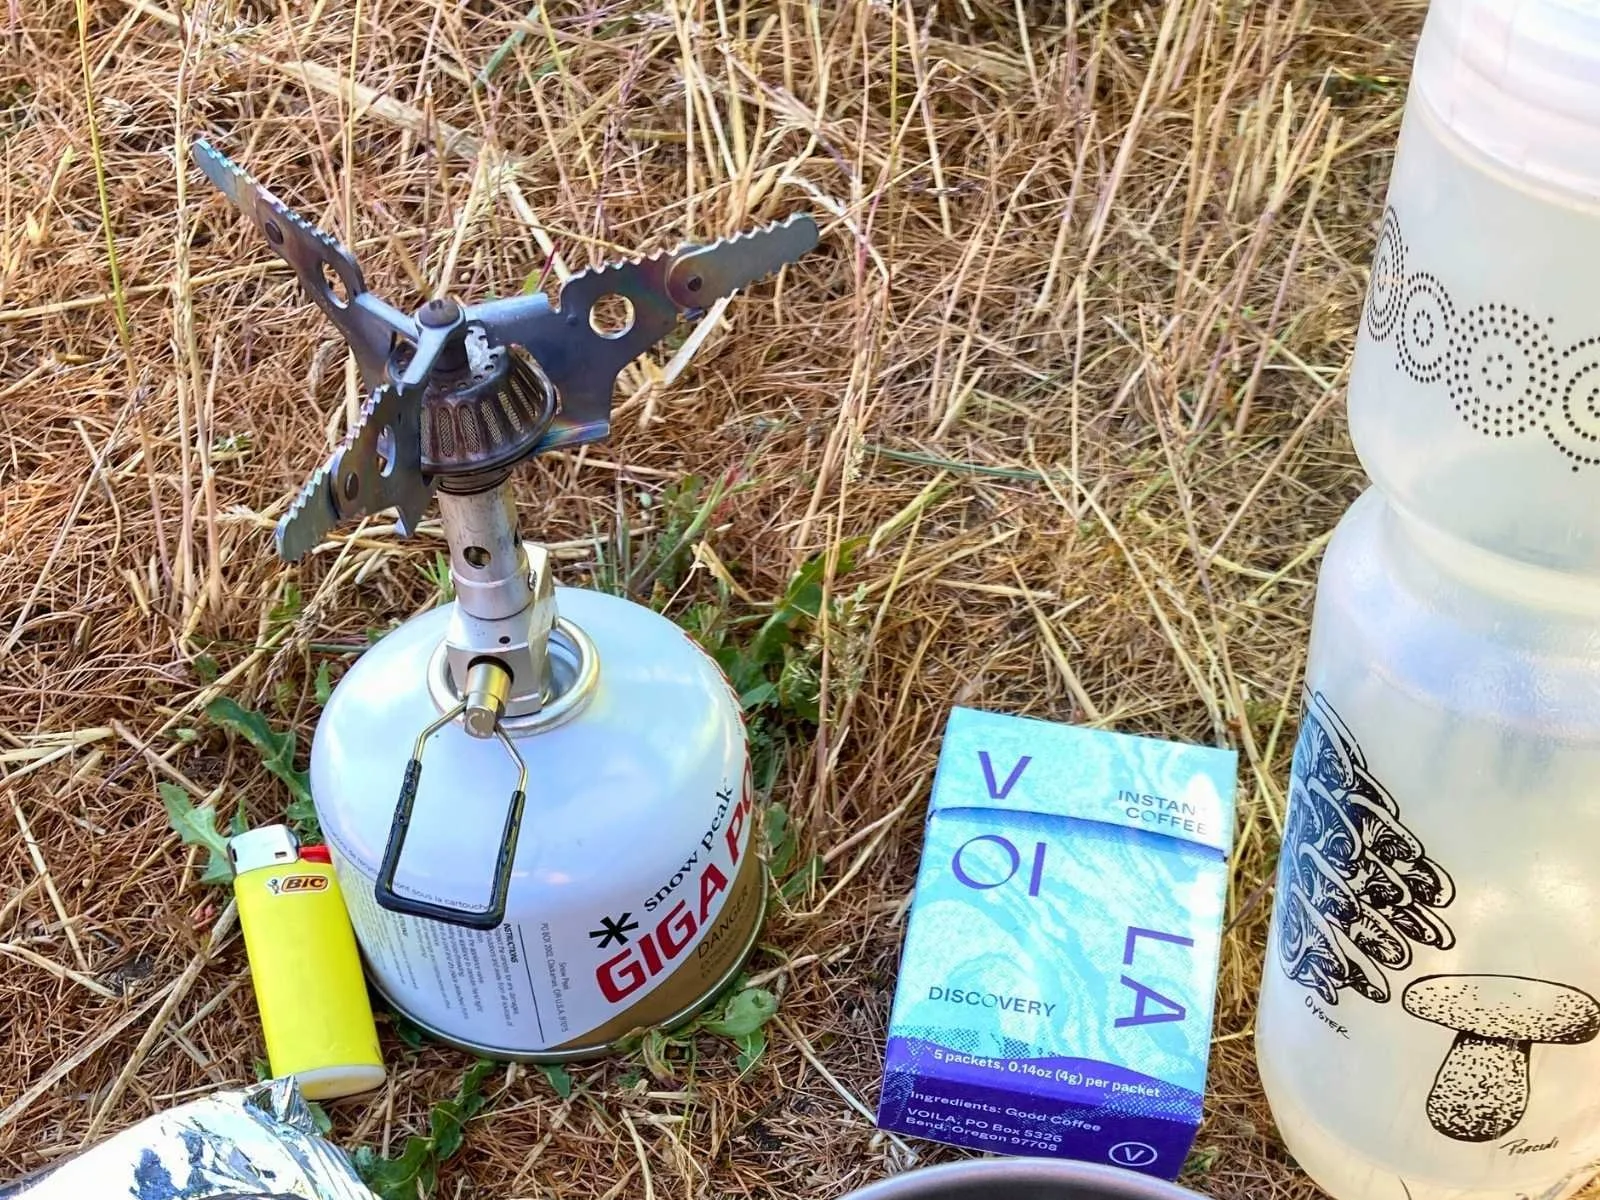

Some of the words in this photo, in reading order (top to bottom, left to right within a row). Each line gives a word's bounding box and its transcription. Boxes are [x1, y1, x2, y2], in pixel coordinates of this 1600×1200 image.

[978, 751, 1032, 800] V
[1118, 790, 1204, 816] INSTAN
[1126, 807, 1207, 835] COFFEE
[644, 851, 698, 912] snow
[701, 787, 734, 852] peak
[286, 878, 325, 890] BIC
[596, 863, 729, 1004] GIGA
[726, 757, 753, 867] PO
[698, 884, 749, 959] DANGER
[928, 986, 1057, 1017] DISCOVERY
[934, 1049, 944, 1060] 5
[945, 1052, 1005, 1072] packets,
[1008, 1061, 1052, 1080] 0.14oz
[1055, 1069, 1083, 1087] (4g)
[1085, 1076, 1109, 1090] per
[1112, 1079, 1161, 1098] packet
[911, 1091, 1001, 1114] Ingredients:
[1005, 1107, 1047, 1122] Good
[1050, 1116, 1102, 1132] Coffee
[965, 1118, 989, 1129] PO
[992, 1124, 1020, 1136] Box
[951, 1126, 1008, 1142] Oregon
[1123, 1147, 1145, 1162] V
